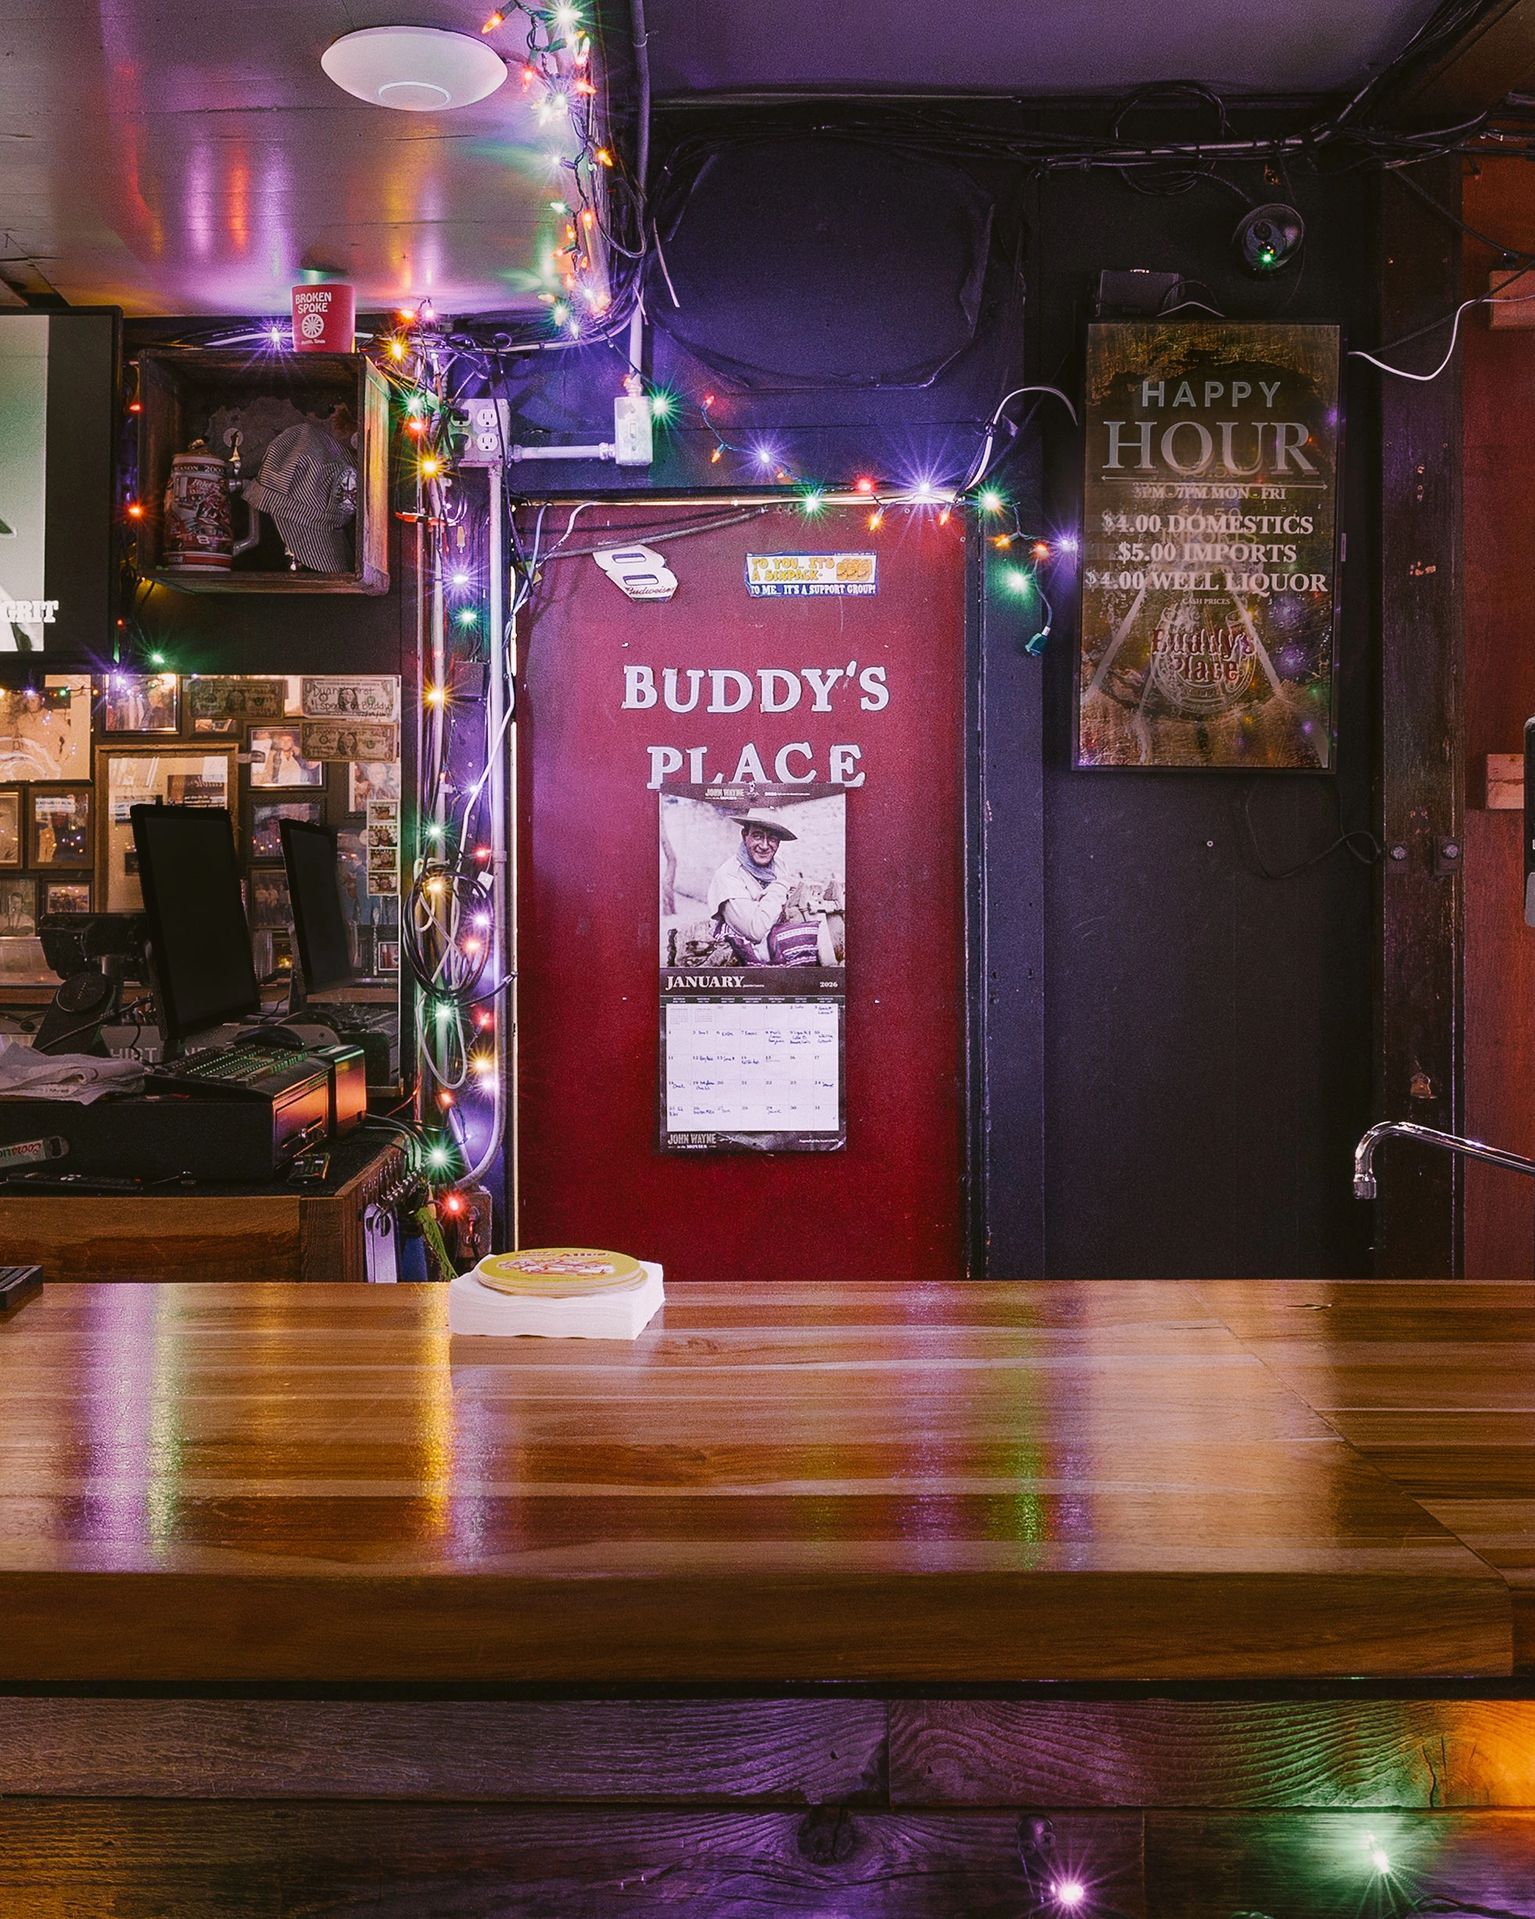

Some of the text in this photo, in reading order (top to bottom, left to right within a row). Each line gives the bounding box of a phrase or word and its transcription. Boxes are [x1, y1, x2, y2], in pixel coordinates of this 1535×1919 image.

[295, 292, 332, 305] BROKEN
[297, 302, 328, 314] SPOKE
[1142, 381, 1281, 408] HAPPY
[1102, 421, 1321, 475] HOUR
[1211, 487, 1250, 499] MON
[1260, 487, 1286, 500] FRI
[1103, 512, 1314, 535] $4.00 DOMESTICS
[1118, 541, 1298, 564] $5.00 IMPORTS
[750, 585, 760, 595] TO
[783, 584, 800, 595] IT'S
[801, 584, 809, 595] A
[809, 584, 845, 595] SUPPORT
[847, 584, 876, 595] GROUP!
[1085, 570, 1328, 596] $4.00 WELL LIQUOR
[621, 660, 890, 713] BUDDY'S
[646, 742, 866, 790] PLACE
[665, 975, 745, 991] JANUARY
[668, 1133, 717, 1144] JOHN WAYNE
